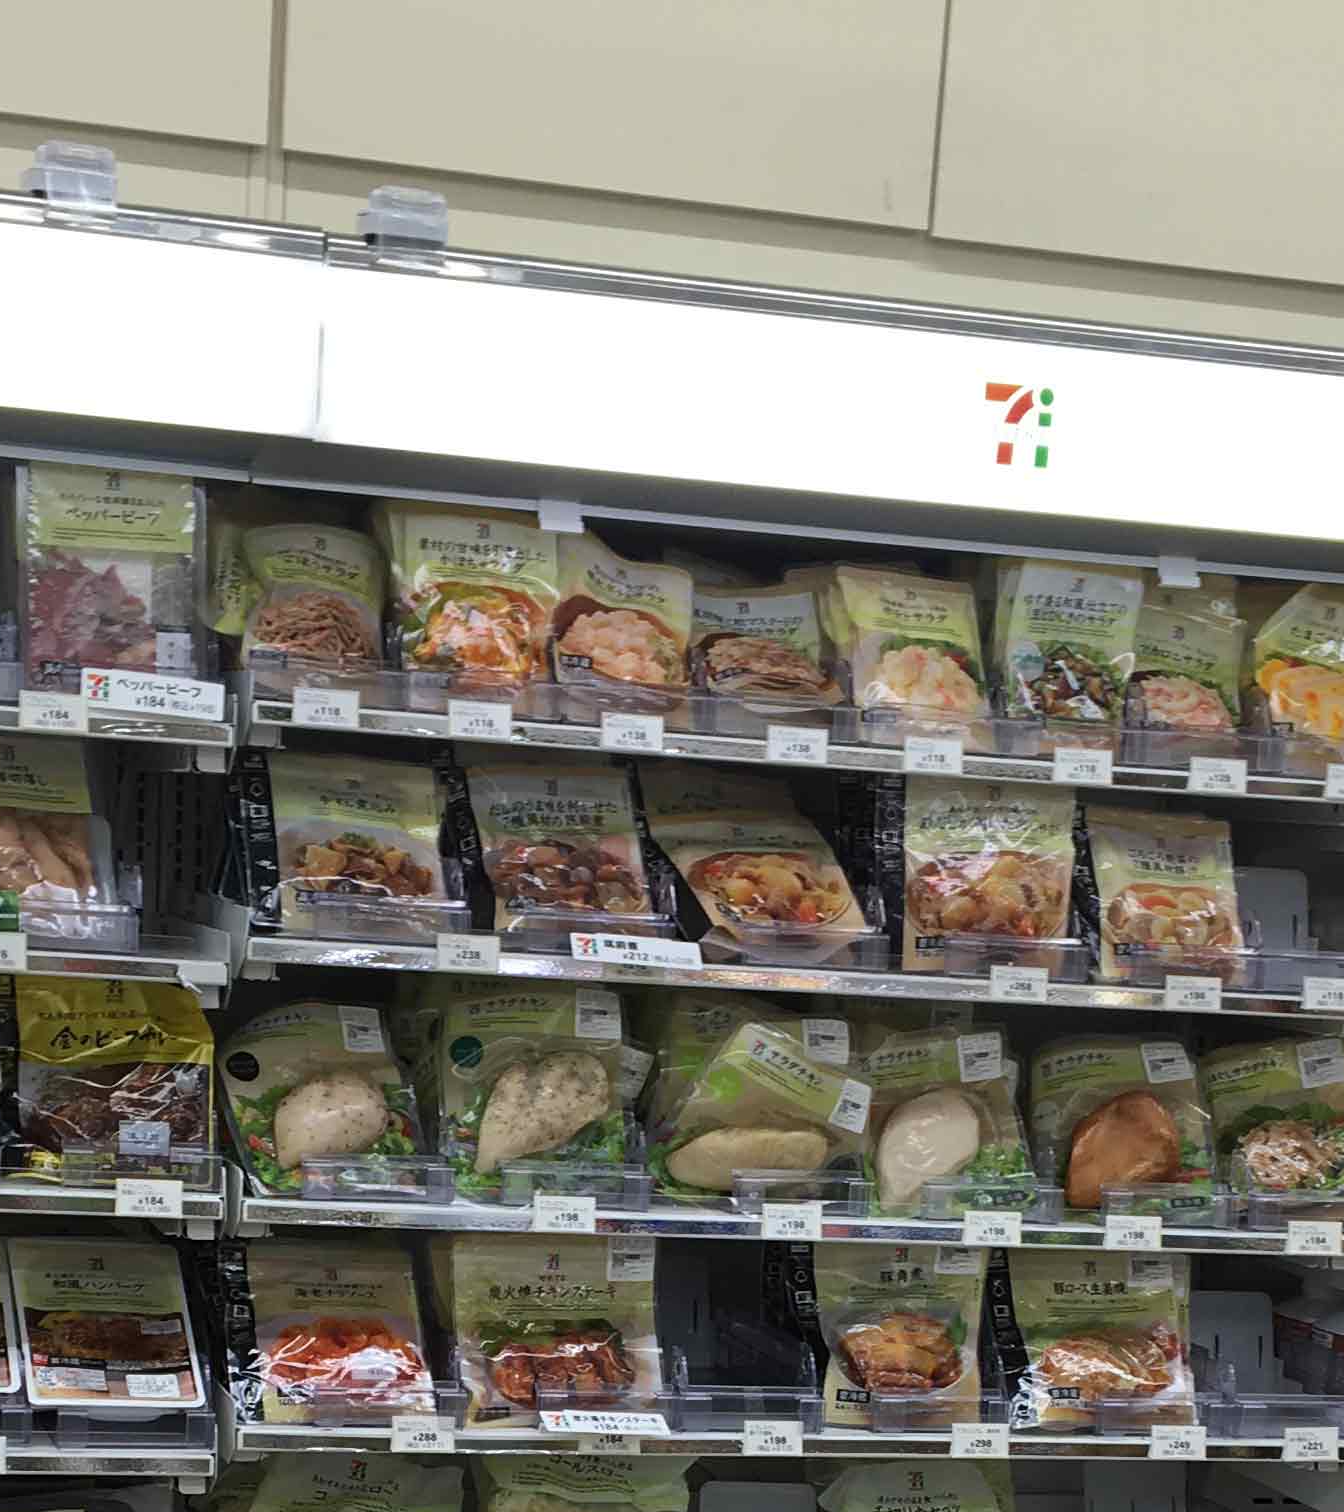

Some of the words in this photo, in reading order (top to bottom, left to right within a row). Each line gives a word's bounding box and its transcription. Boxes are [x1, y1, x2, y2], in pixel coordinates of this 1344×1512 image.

[117, 679, 203, 698] ペッパービーフ
